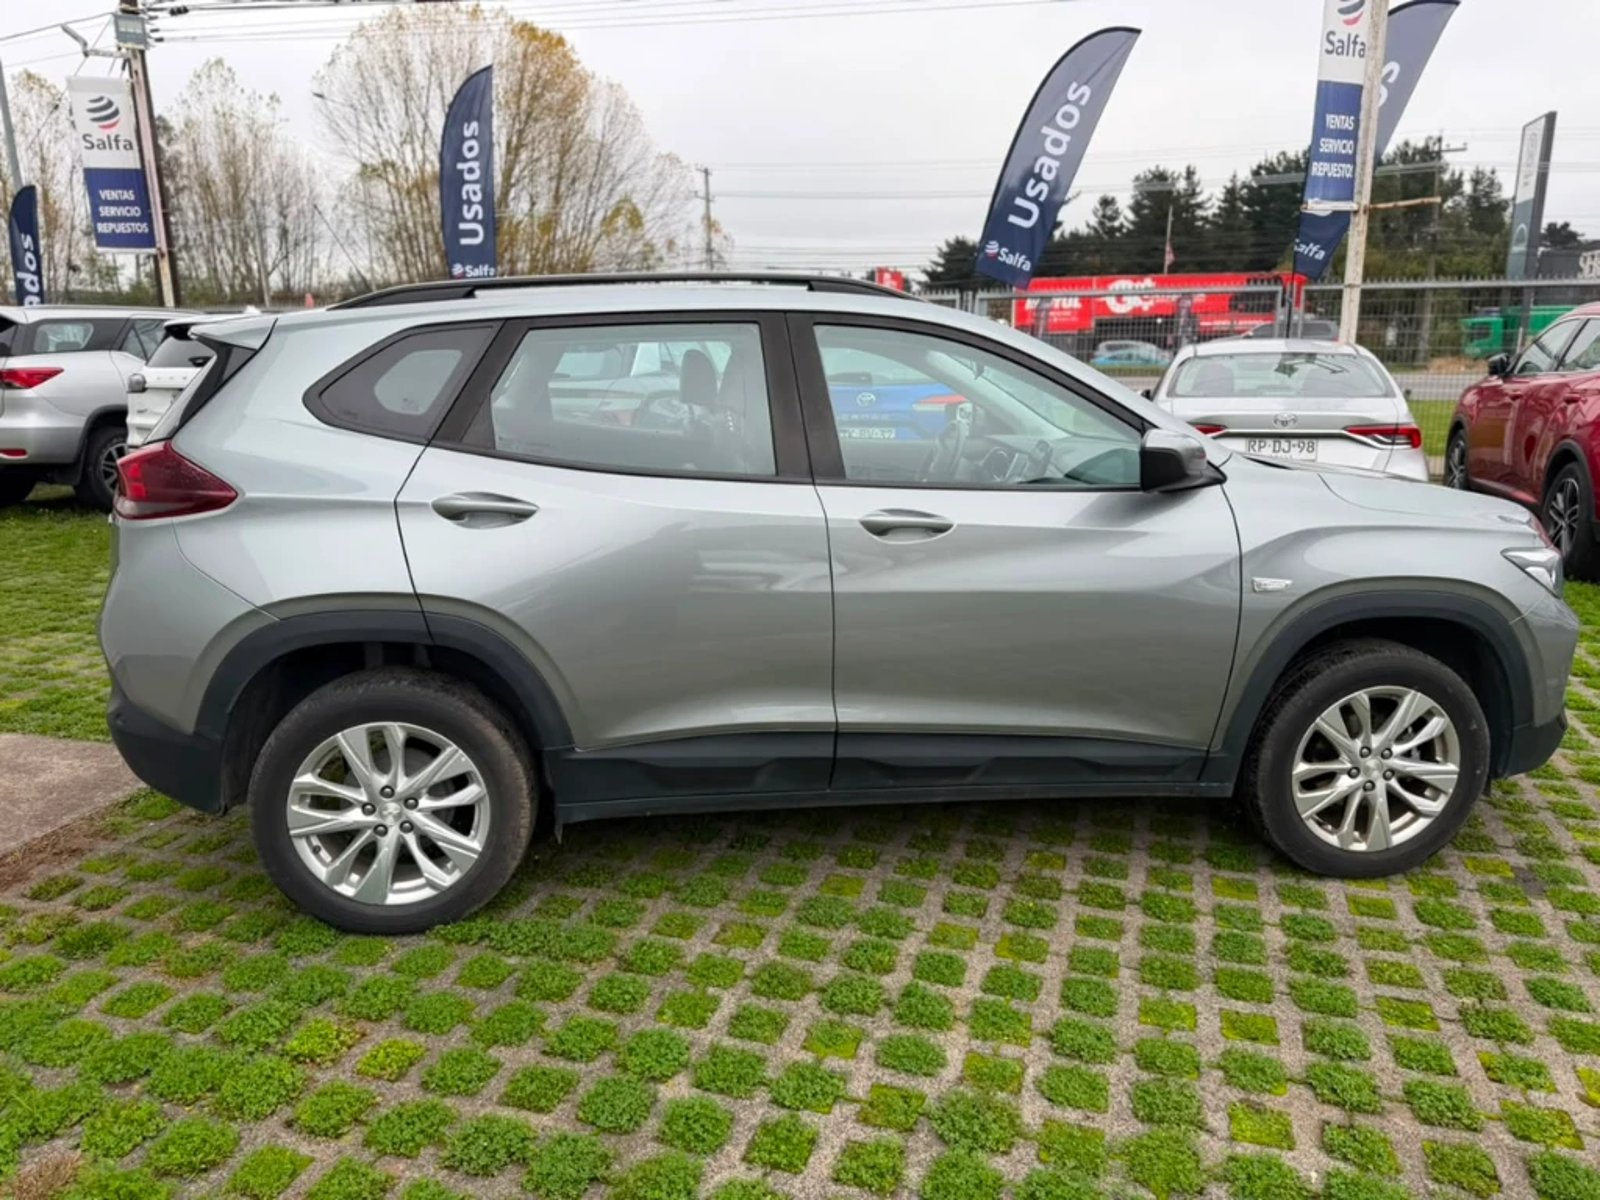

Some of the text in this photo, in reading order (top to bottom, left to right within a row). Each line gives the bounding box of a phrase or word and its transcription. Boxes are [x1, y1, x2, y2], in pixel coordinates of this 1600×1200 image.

[1324, 30, 1366, 59] Salfa
[1325, 113, 1355, 130] VENTAS
[82, 134, 134, 151] Salfa
[1319, 138, 1354, 154] SERVICIO
[1007, 81, 1092, 229] Usados
[456, 120, 485, 245] Usados
[99, 190, 135, 201] VENTAS
[98, 206, 142, 217] SERVICIO
[97, 222, 149, 234] REPUESTOS
[997, 247, 1031, 272] Salfa
[16, 233, 41, 306] ados
